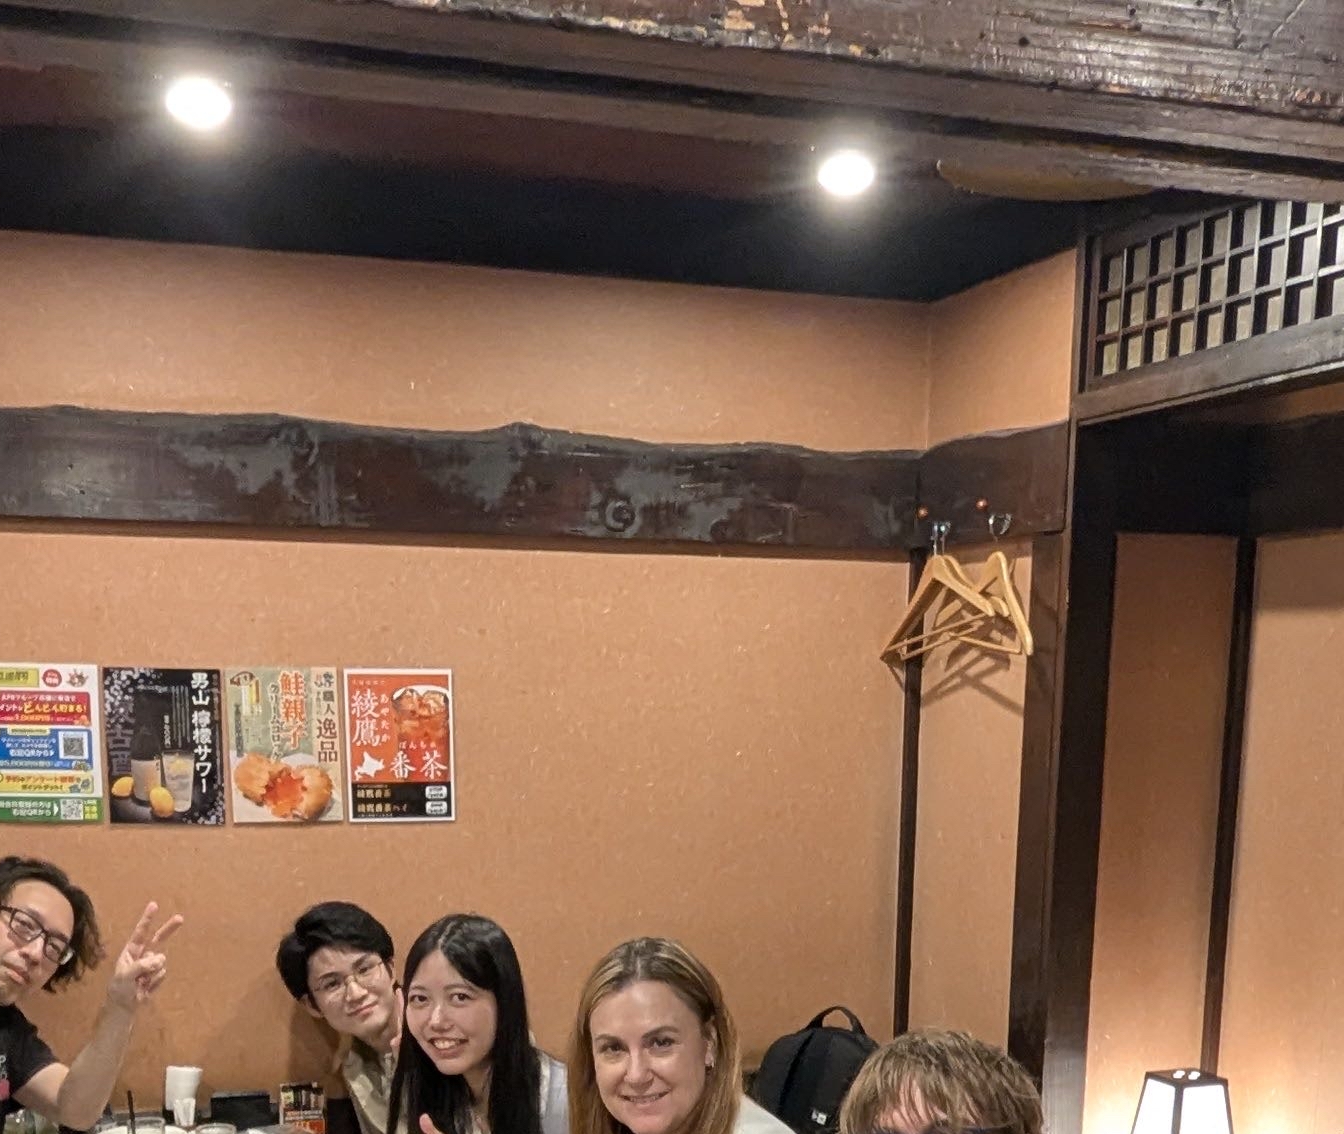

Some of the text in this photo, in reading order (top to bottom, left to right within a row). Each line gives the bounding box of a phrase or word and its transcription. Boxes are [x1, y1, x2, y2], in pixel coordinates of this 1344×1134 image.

[280, 671, 305, 750] 鮭親子
[351, 688, 380, 747] 綾鷹
[316, 718, 338, 763] 逸品
[390, 750, 448, 779] 番茶
